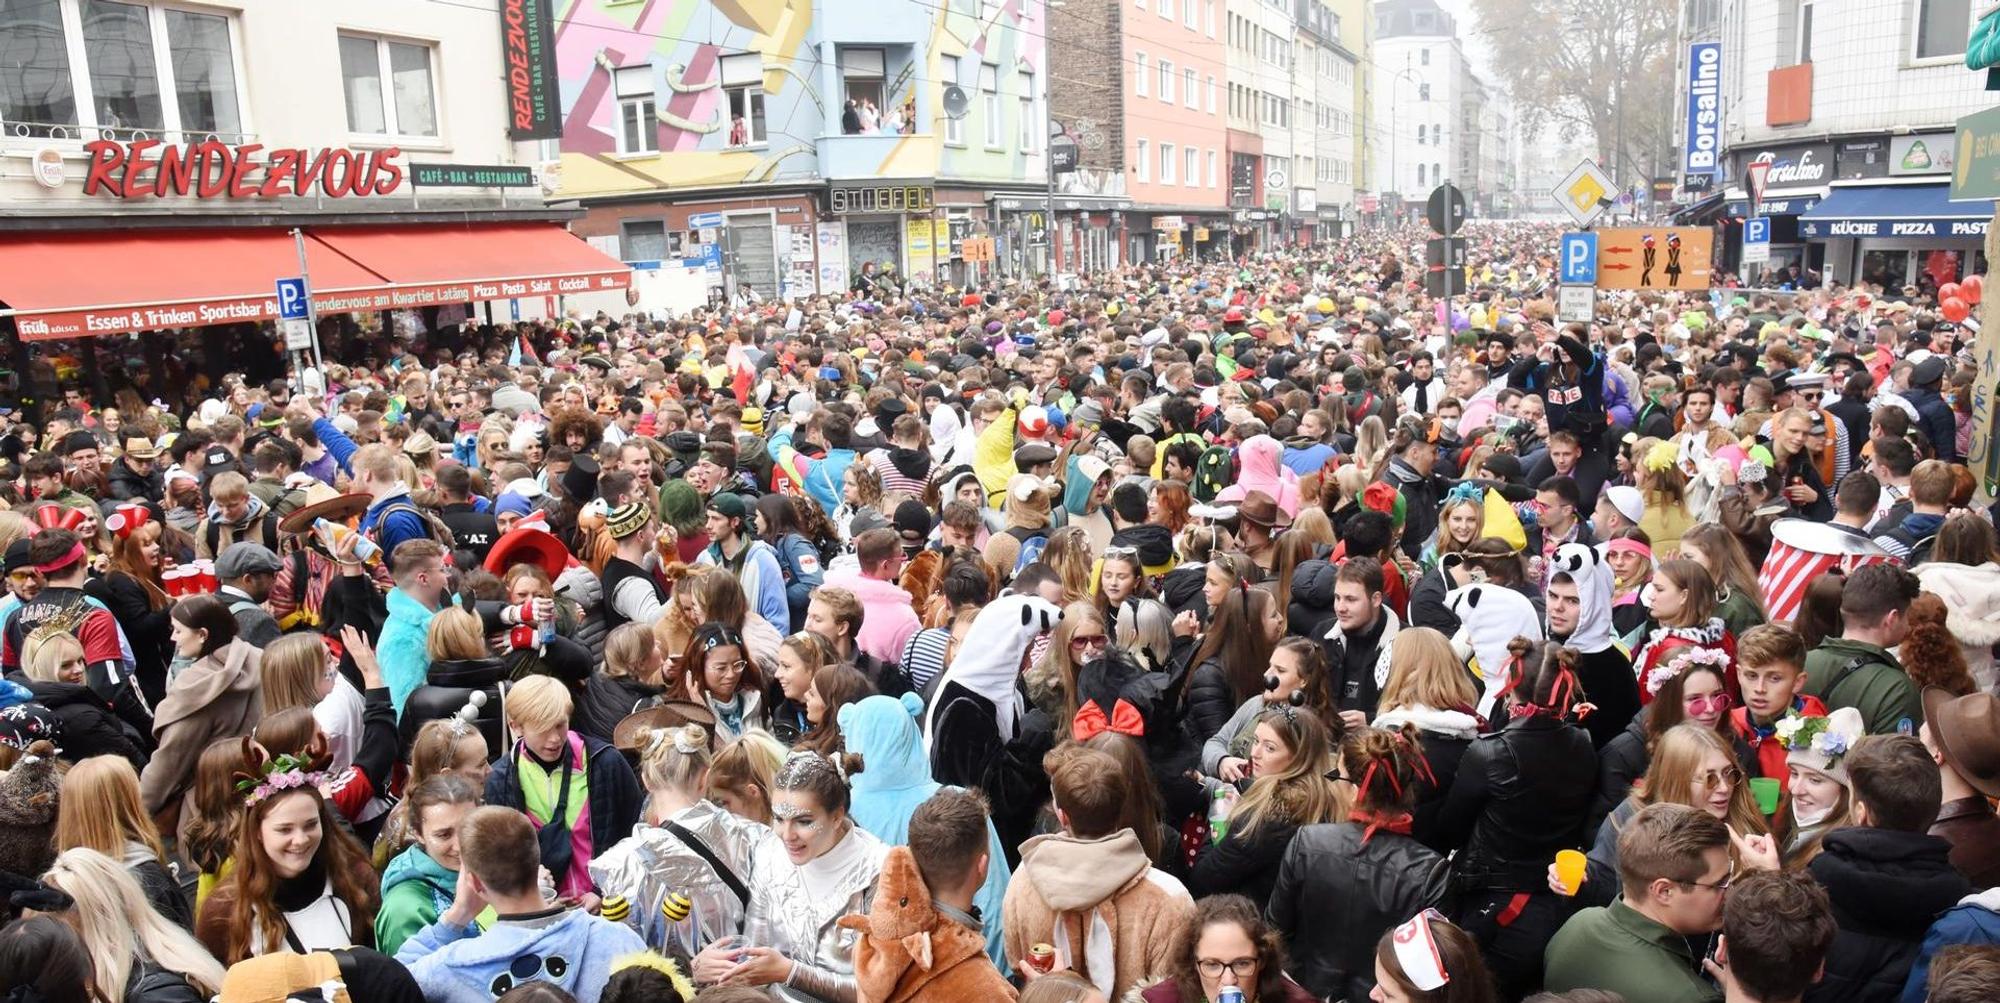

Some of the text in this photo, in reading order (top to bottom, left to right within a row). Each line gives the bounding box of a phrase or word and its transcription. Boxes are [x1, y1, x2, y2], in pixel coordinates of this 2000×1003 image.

[533, 64, 543, 86] BAR
[1689, 47, 1719, 168] Borsalino
[82, 138, 403, 198] RENDEZVOUS
[419, 169, 528, 185] CAFÉ BAR RESTAURANT
[1686, 175, 1709, 187] sky
[832, 188, 933, 211] STIEFEL
[1750, 221, 1764, 241] P
[1830, 220, 1990, 235] KÜCHE PIZZA PAST
[1568, 239, 1588, 277] P
[20, 320, 49, 335] früh
[86, 314, 130, 331] Essen
[132, 311, 144, 328] &
[145, 308, 196, 326] Trinken
[199, 302, 262, 322] Sportsbar
[315, 297, 371, 312] endezvous
[374, 295, 390, 306] am
[392, 288, 434, 305] Kwartier
[437, 286, 469, 301] Latäng
[473, 285, 498, 298] Pizza
[502, 283, 526, 295] Pasta
[531, 280, 553, 293] Salat
[558, 277, 590, 291] Cocktail
[281, 283, 298, 314] P
